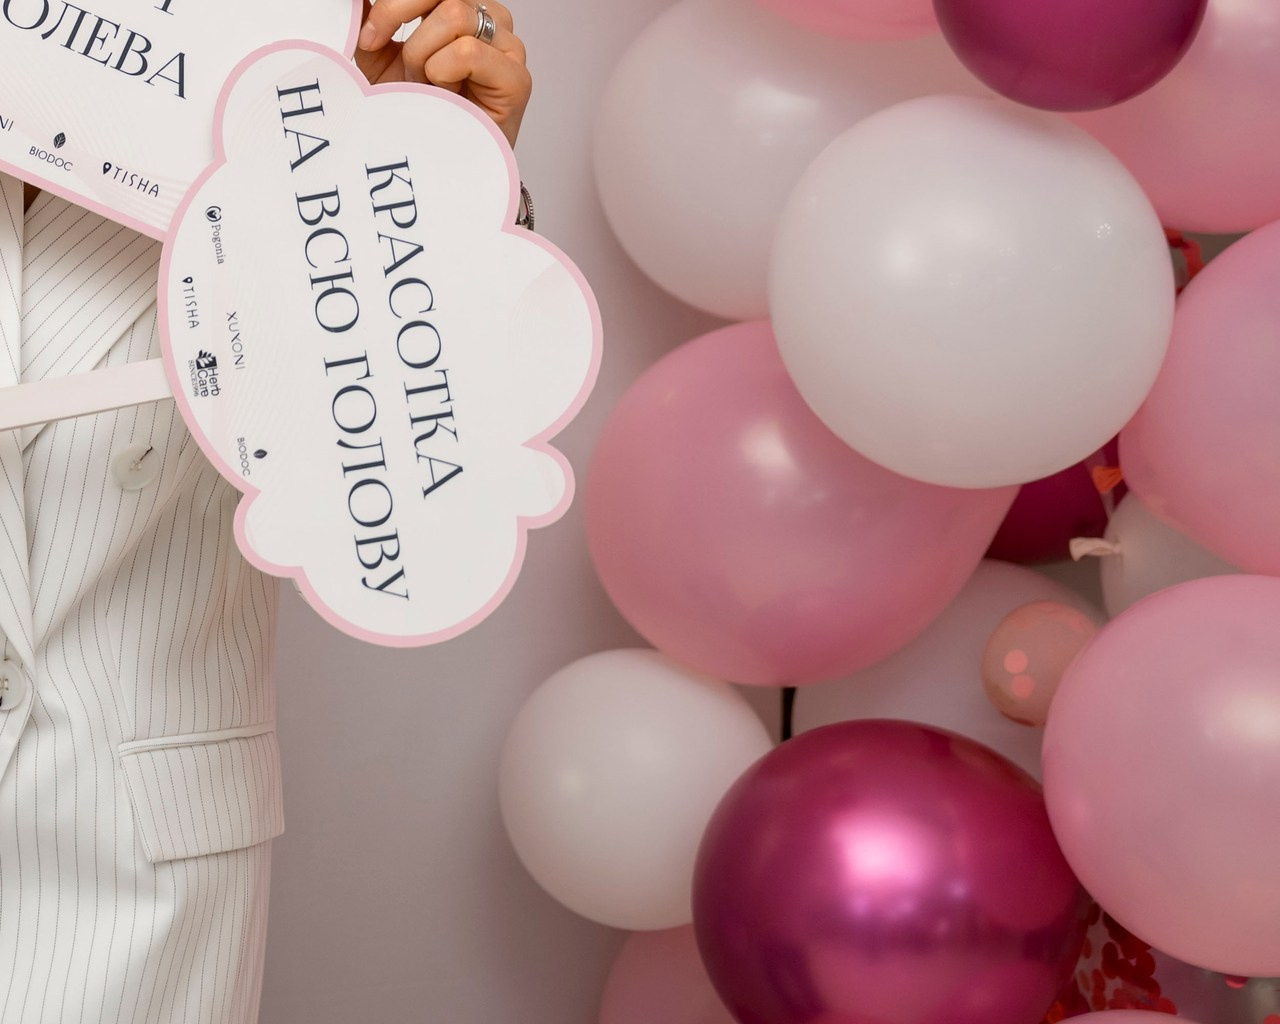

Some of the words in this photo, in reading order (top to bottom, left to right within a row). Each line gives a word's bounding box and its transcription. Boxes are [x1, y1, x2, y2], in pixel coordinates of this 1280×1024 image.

[276, 77, 330, 172] НА
[29, 146, 73, 172] BIODOC
[114, 167, 160, 198] TISHA
[211, 224, 224, 265] Pogonia
[295, 184, 360, 333] ВСЮ
[183, 286, 200, 329] TISHA
[365, 155, 464, 500] КРАСОТКА
[197, 370, 209, 398] Care
[207, 367, 220, 397] Herb
[237, 437, 251, 476] BIODOC
[323, 350, 410, 601] ГОЛОВУ
